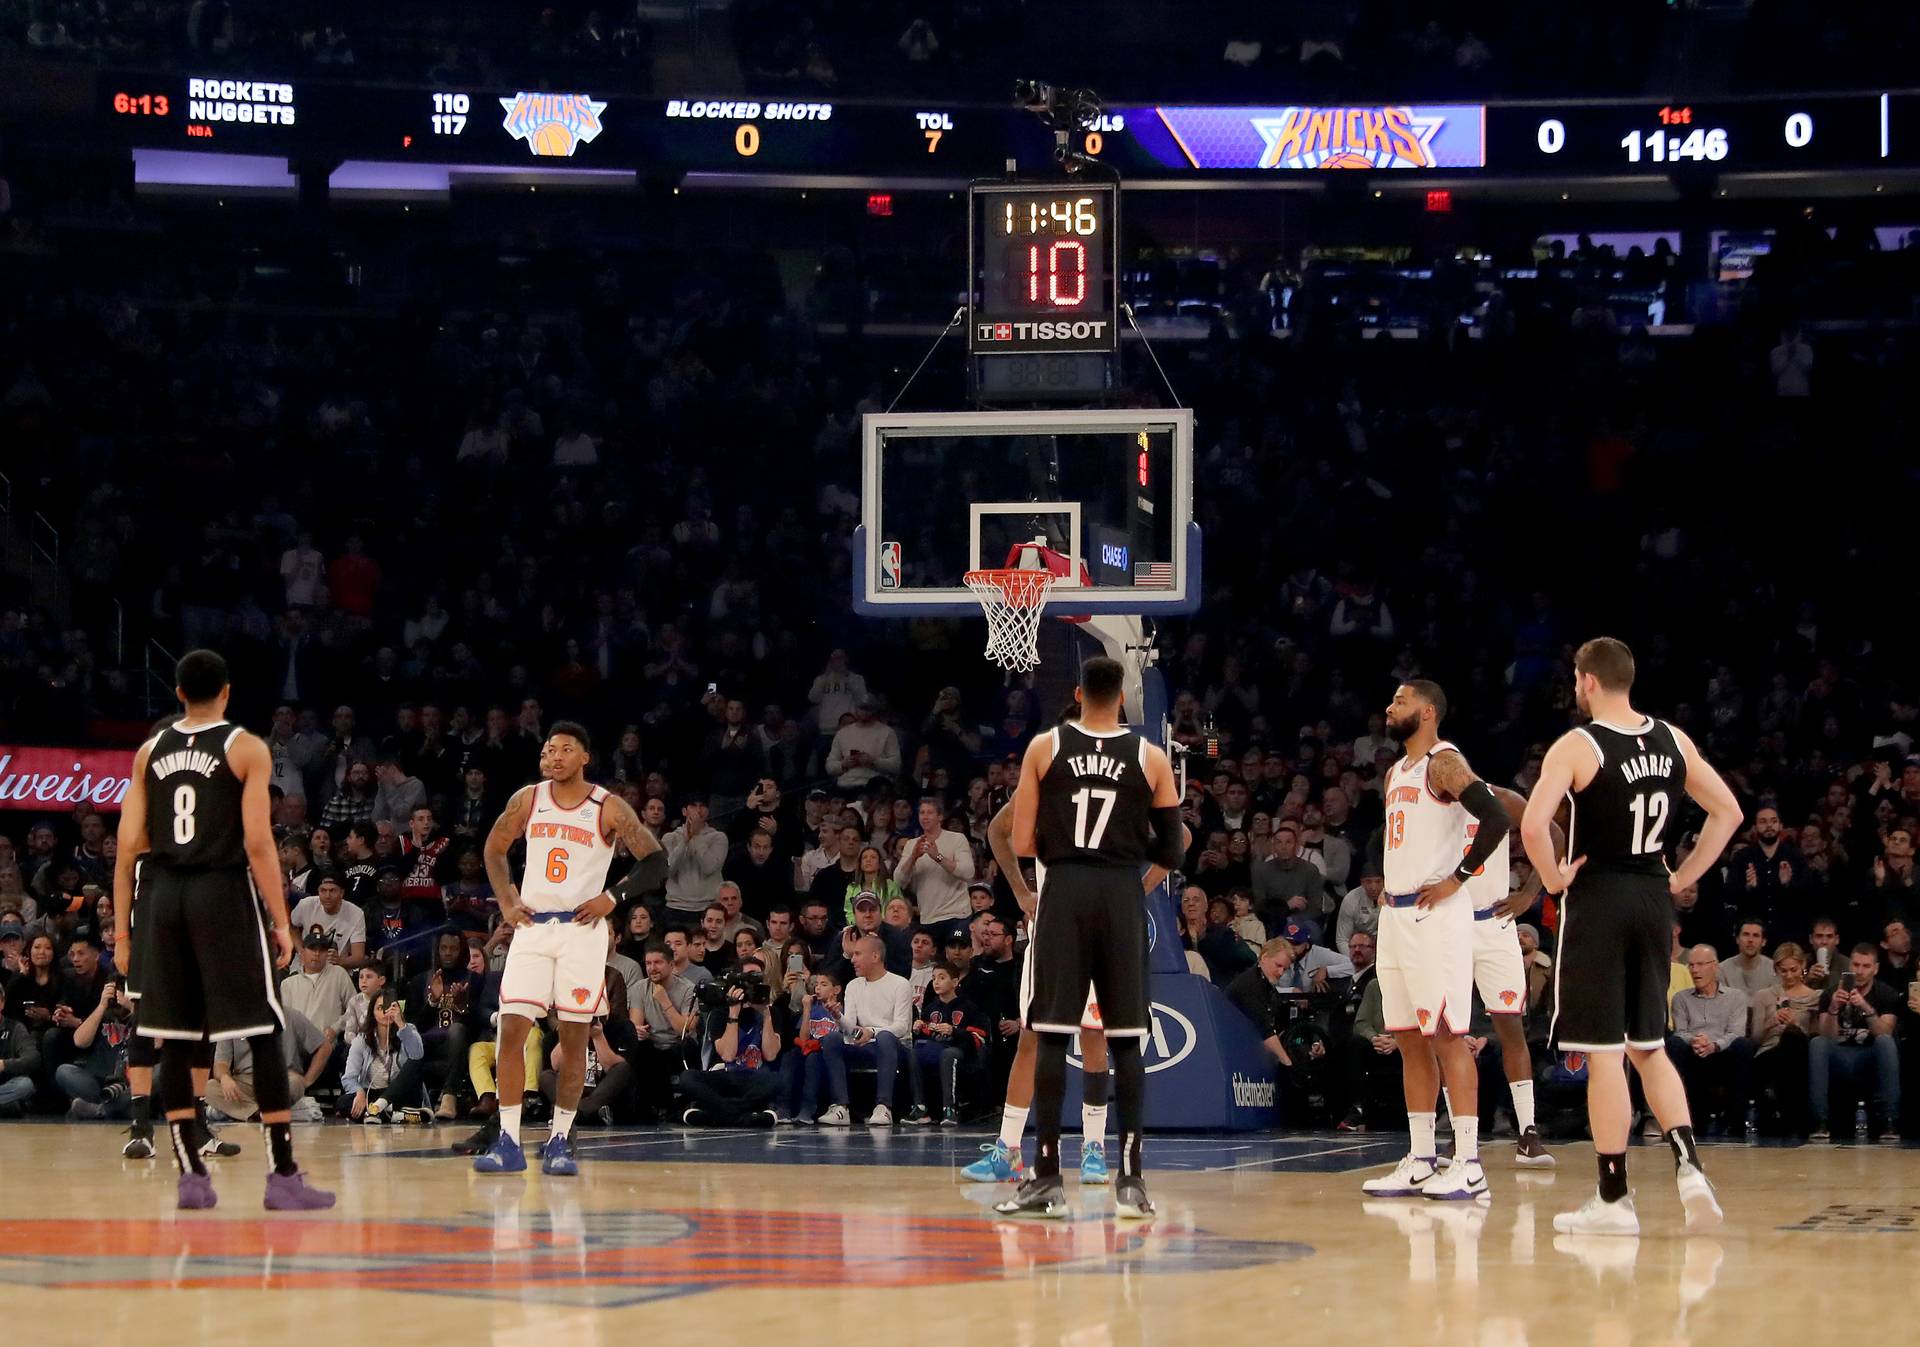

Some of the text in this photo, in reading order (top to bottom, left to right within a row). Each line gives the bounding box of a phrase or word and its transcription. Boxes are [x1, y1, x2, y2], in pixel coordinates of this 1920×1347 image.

[113, 92, 169, 116] 6:13
[188, 78, 294, 104] ROCKETS
[432, 92, 470, 114] 110
[188, 100, 296, 126] NUGGETS
[431, 113, 468, 135] 117
[508, 93, 600, 129] KNICKS
[665, 101, 833, 121] BLOCKED SHOTS
[916, 113, 954, 131] TOL
[1658, 107, 1692, 125] 1st
[187, 125, 213, 138] NBA
[735, 124, 760, 157] 0
[924, 131, 943, 153] 7
[1085, 132, 1102, 155] 0
[1268, 106, 1427, 169] KNICKS
[1537, 119, 1566, 154] 0
[1784, 112, 1814, 148] 0
[1621, 127, 1729, 163] 11:46
[1005, 198, 1096, 236] 11:46
[1030, 240, 1085, 306] 10
[1013, 321, 1107, 340] TISSOT
[1102, 544, 1122, 567] CHASE
[151, 751, 220, 781] DINWIDDIE
[1067, 754, 1126, 781] TEMPLE
[1620, 754, 1673, 784] HARRIS
[174, 784, 196, 845] 8
[1071, 788, 1117, 850] 17
[1629, 791, 1669, 855] 12
[530, 823, 595, 849] NEW YORK
[1388, 810, 1405, 850] 13
[345, 864, 377, 878] BROOKLYN
[545, 847, 569, 884] 6
[352, 876, 361, 891] 7
[1232, 1071, 1274, 1108] ticketmaster
